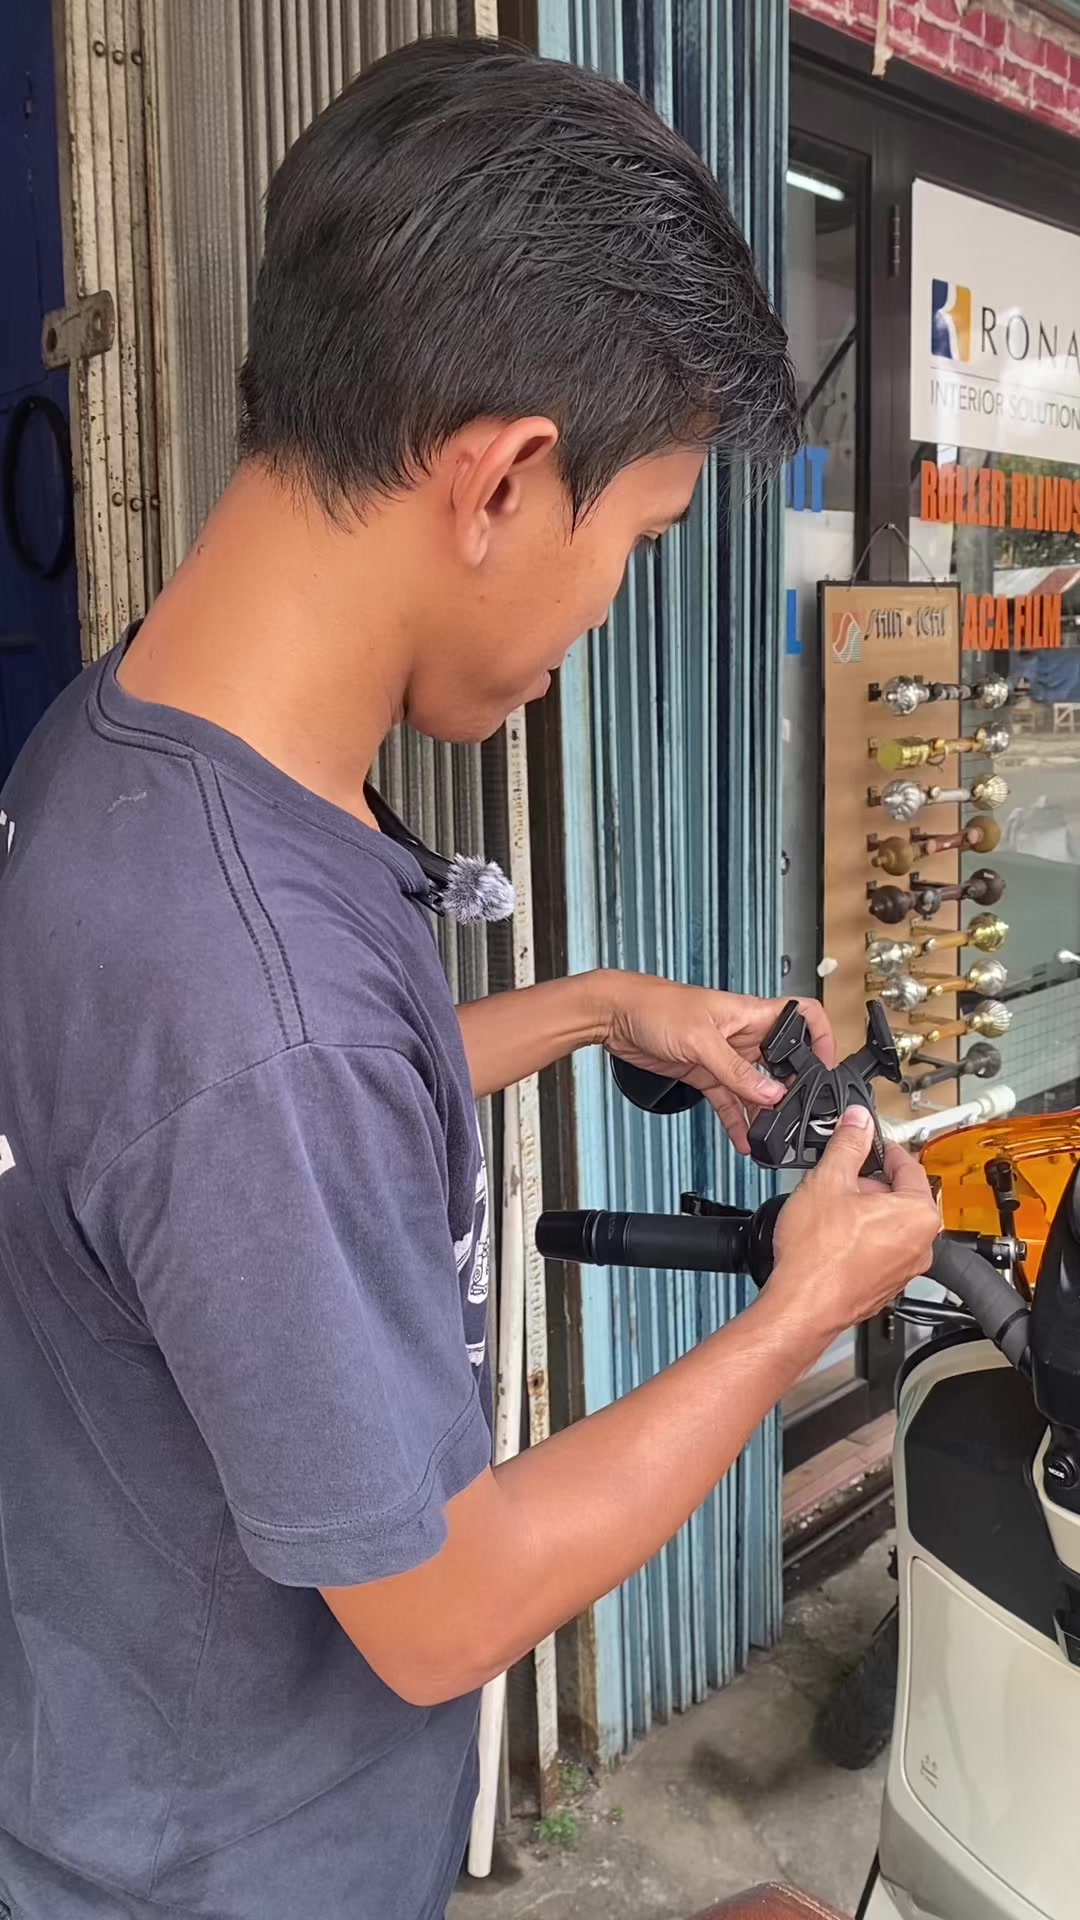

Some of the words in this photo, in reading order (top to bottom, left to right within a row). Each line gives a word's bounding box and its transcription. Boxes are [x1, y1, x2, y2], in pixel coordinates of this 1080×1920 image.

[930, 379, 1004, 416] INTERIOR
[920, 460, 1005, 527] ROLLER
[1014, 593, 1062, 649] FILM
